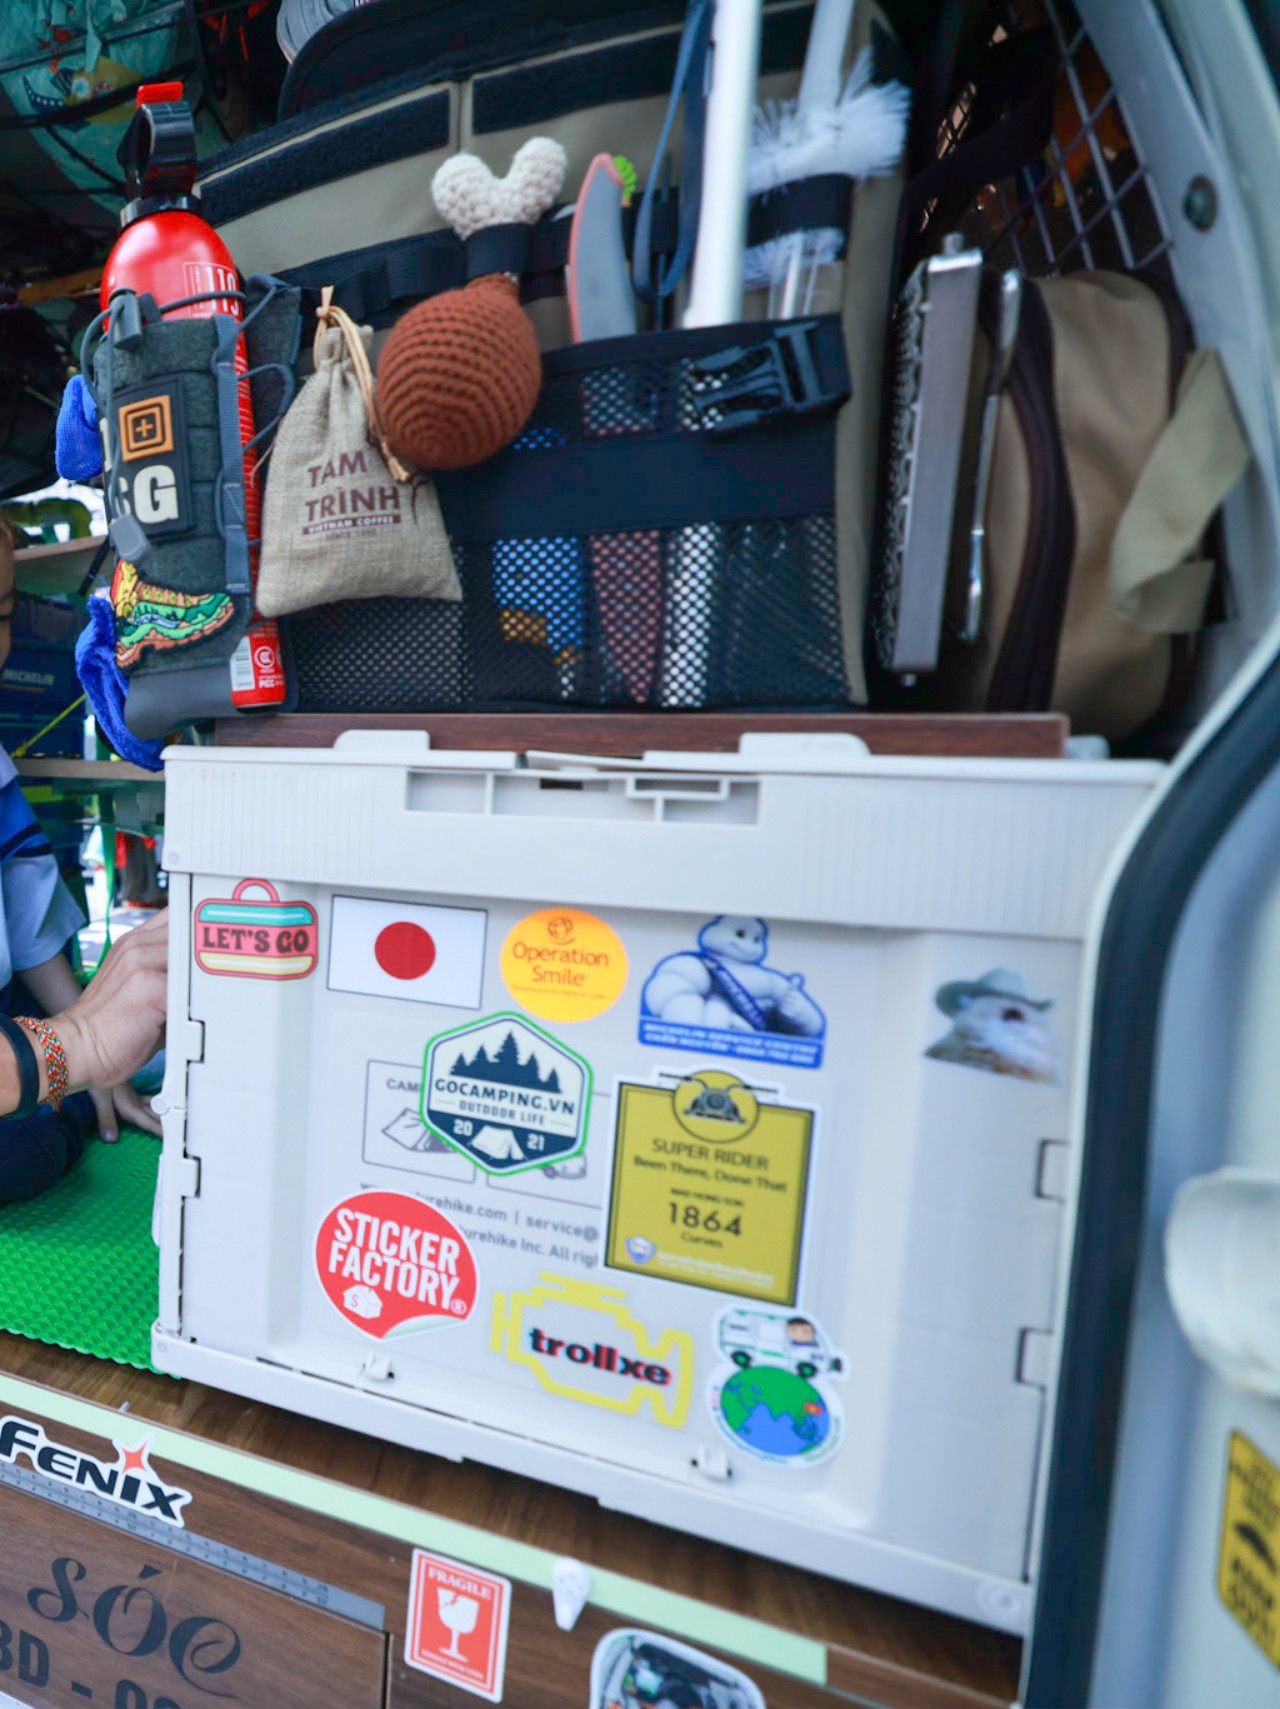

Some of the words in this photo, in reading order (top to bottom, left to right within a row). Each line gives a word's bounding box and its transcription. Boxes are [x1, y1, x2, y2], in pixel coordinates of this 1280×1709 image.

[202, 925, 270, 954] LET'S
[276, 931, 310, 954] GO
[512, 941, 610, 968] Operation
[531, 964, 586, 988] Smile
[434, 1078, 576, 1115] GOCAMPING.VN
[458, 1100, 517, 1120] OUTDOOR
[520, 1108, 547, 1126] LIFE
[453, 1118, 474, 1137] 20
[526, 1133, 546, 1152] 21
[651, 1137, 710, 1162] SUPER
[714, 1148, 770, 1171] RIDER
[633, 1154, 667, 1171] Been
[714, 1169, 753, 1187] Done
[756, 1177, 788, 1193] That
[668, 1201, 743, 1238] 1864
[332, 1205, 461, 1278] STICKER
[549, 1242, 570, 1260] All
[328, 1238, 461, 1309] FACTORY
[528, 1326, 673, 1388] trollxe
[428, 1566, 492, 1601] FRAGILE
